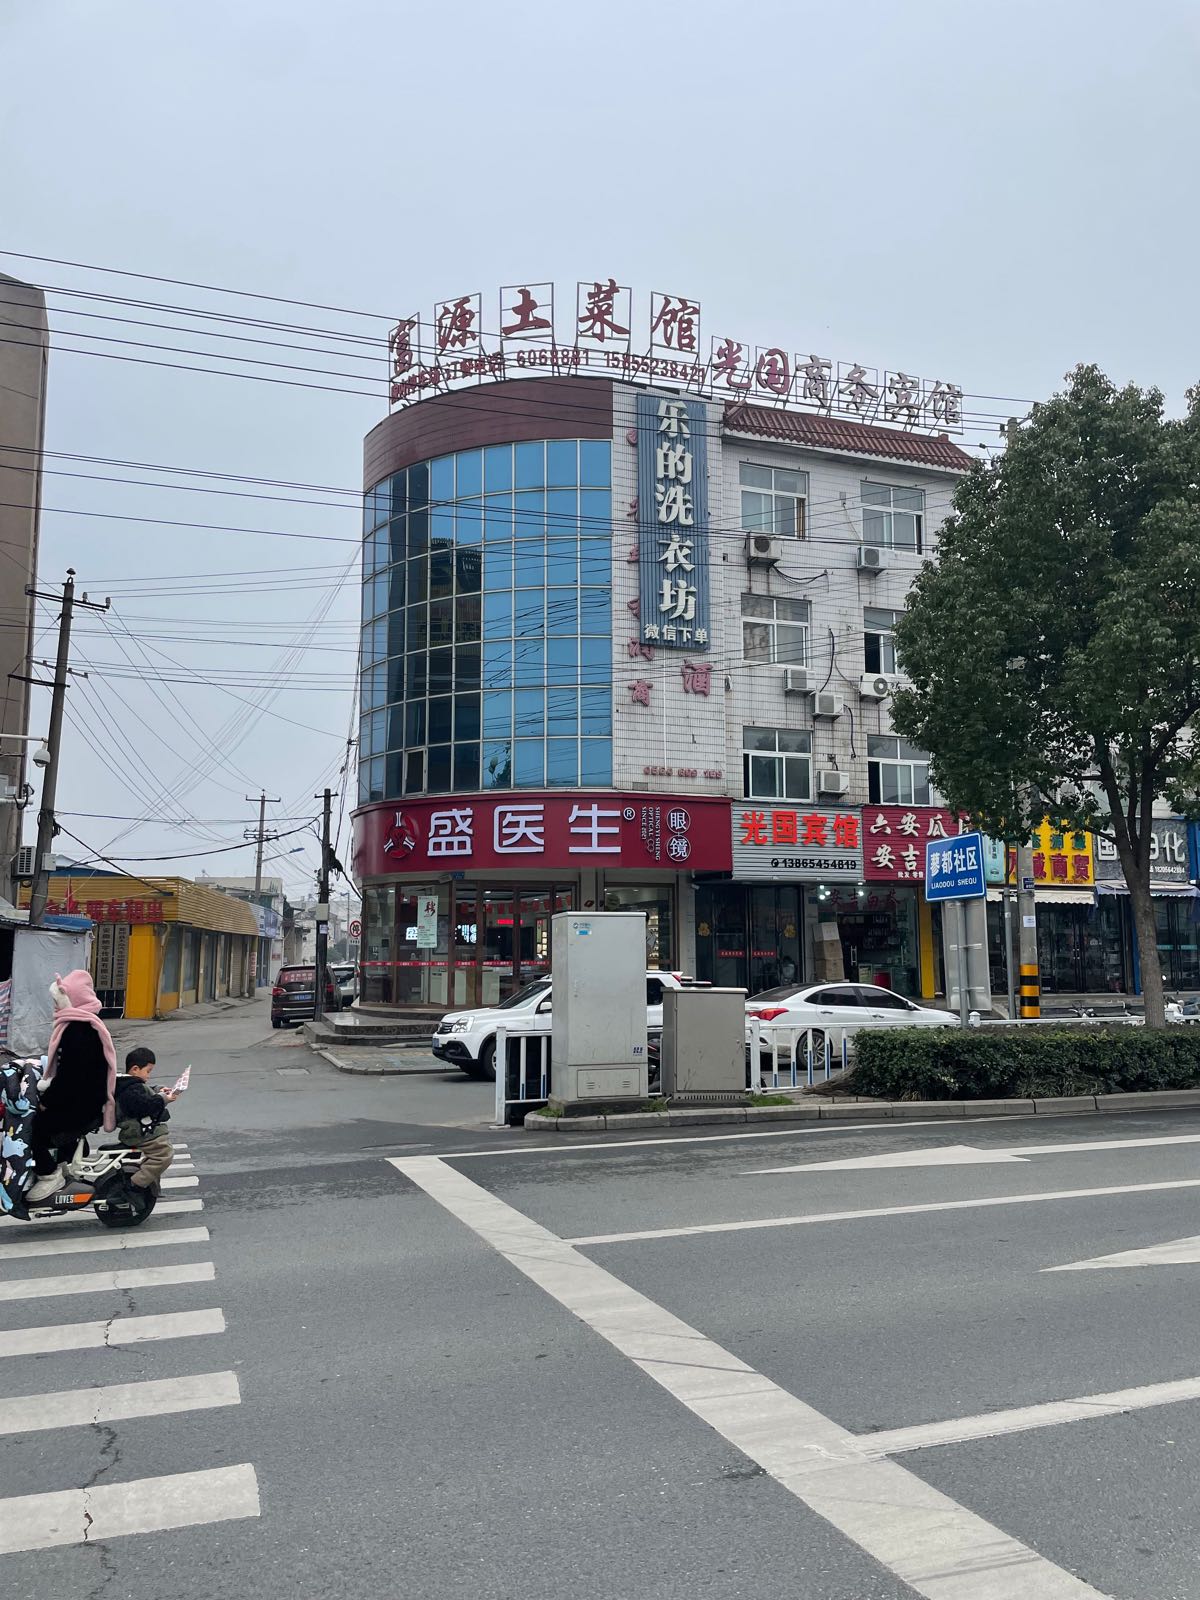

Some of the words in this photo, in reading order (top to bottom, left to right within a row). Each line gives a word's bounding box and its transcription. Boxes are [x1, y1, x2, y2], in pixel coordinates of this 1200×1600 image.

[712, 338, 964, 424] 光国商务宾馆
[655, 399, 697, 622] 乐的洗衣坊
[643, 622, 710, 644] 微信下单
[427, 803, 622, 857] 盛医生
[670, 811, 688, 858] 眼镜
[740, 811, 860, 849] 光国宾馆
[783, 858, 858, 870] 13865454819
[931, 880, 955, 890] LIAODOU
[957, 876, 977, 887] SHEQU
